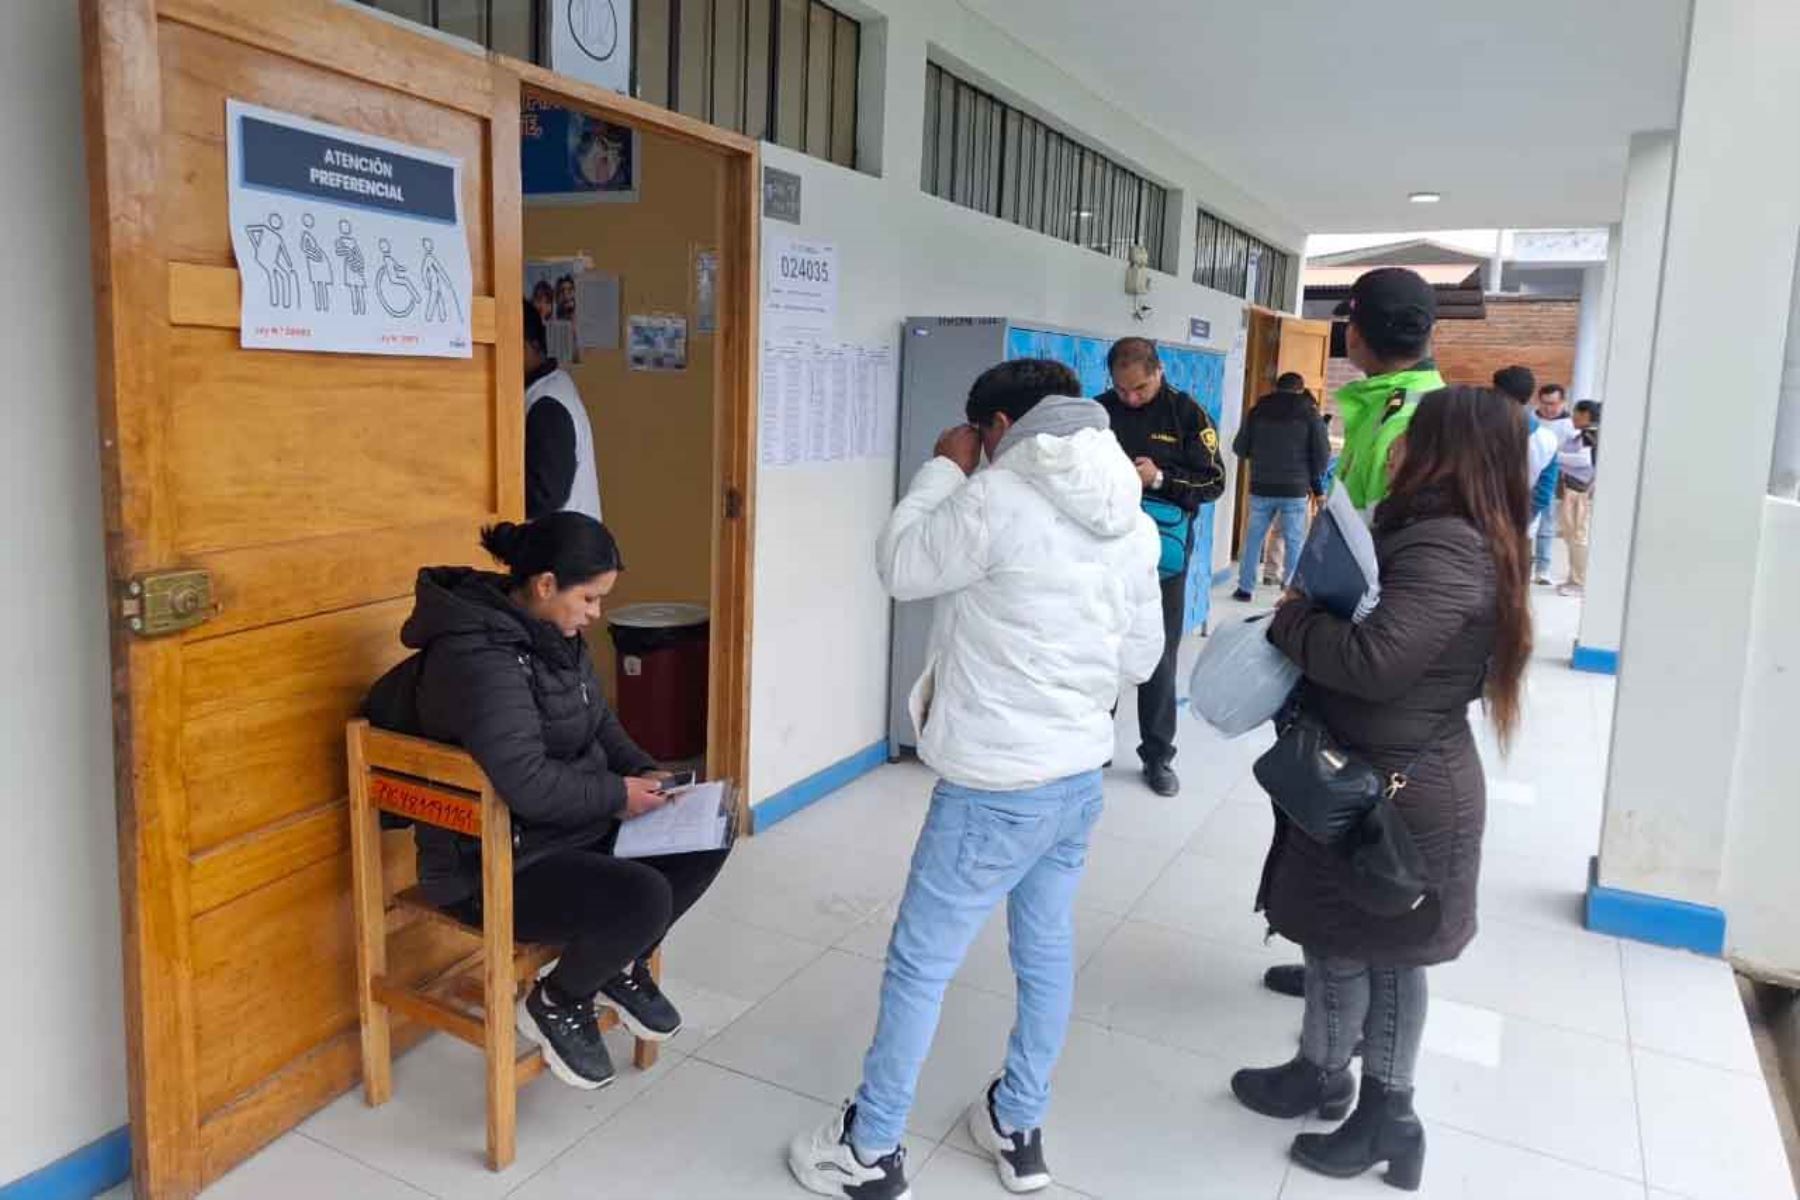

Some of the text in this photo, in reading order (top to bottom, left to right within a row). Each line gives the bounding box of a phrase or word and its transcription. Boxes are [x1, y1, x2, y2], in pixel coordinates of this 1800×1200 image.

[325, 149, 392, 178] ATENCIÓN
[310, 168, 404, 202] PREFERENCIAL
[781, 256, 829, 282] 024035
